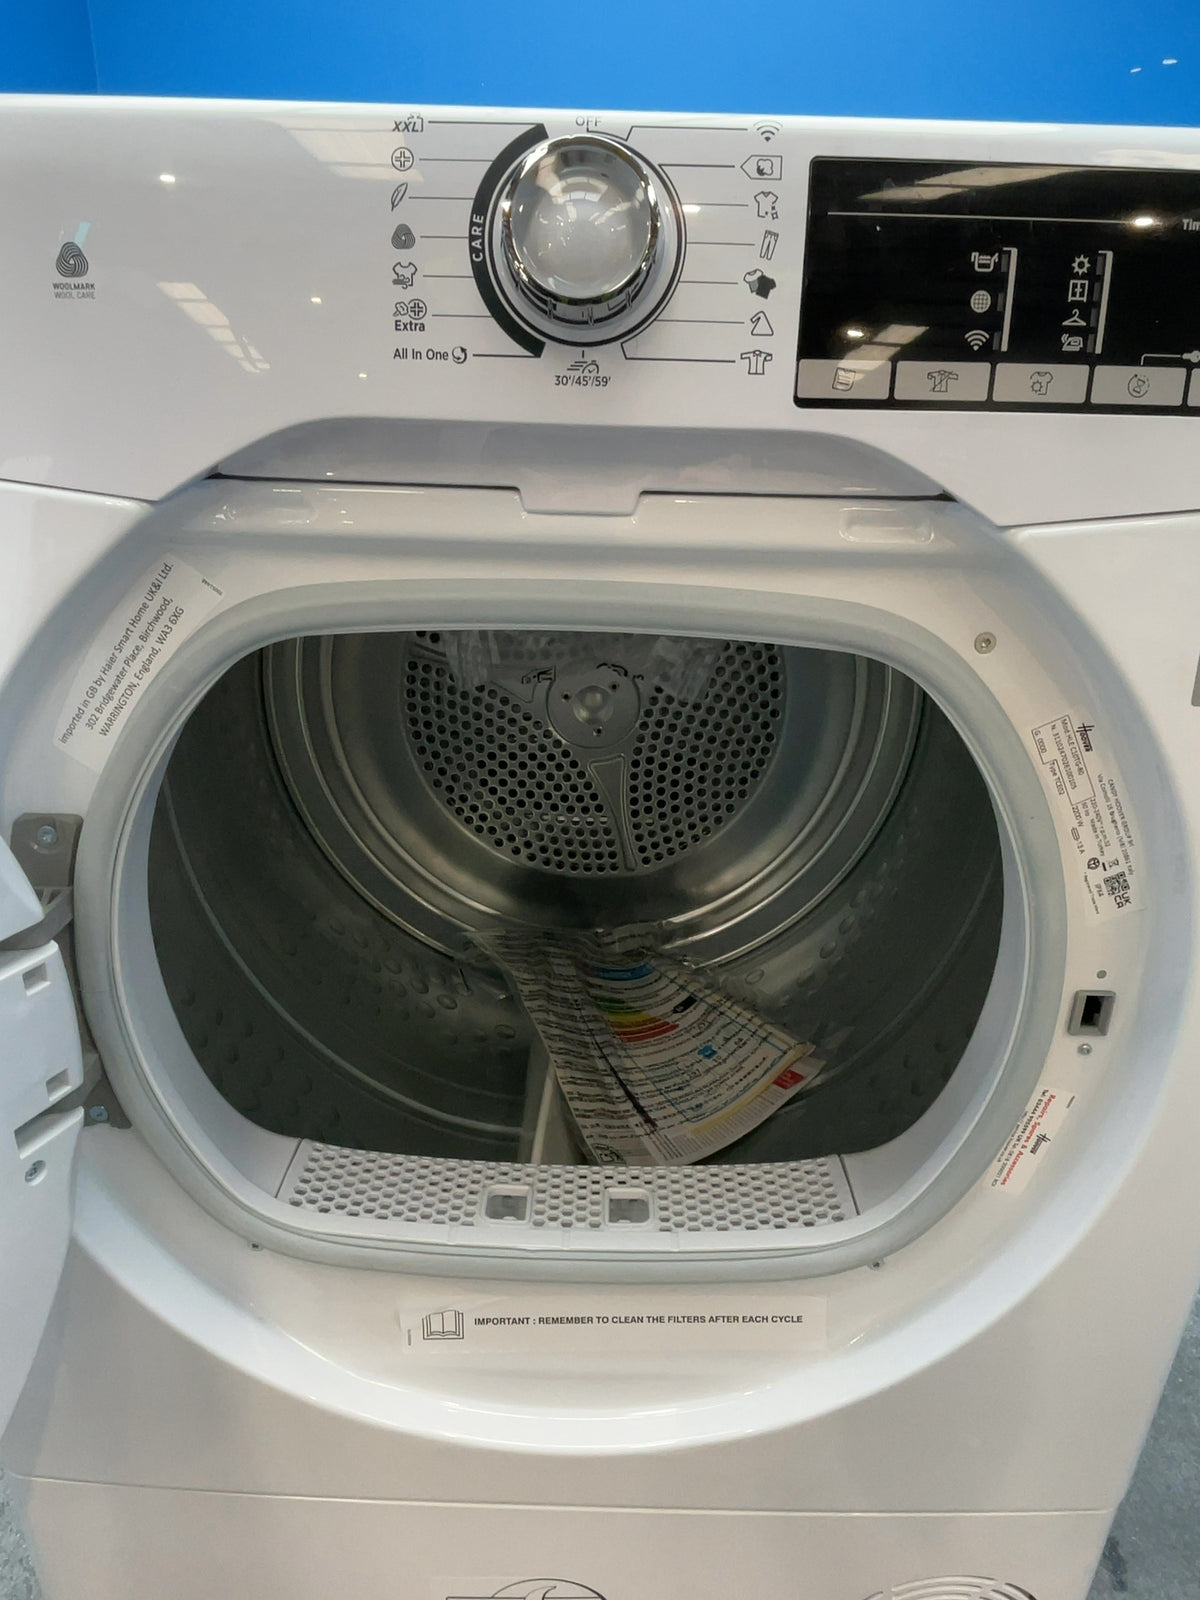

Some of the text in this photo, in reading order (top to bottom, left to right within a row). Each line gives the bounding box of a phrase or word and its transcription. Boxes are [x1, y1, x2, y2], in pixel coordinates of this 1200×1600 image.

[392, 120, 419, 133] XXL
[575, 115, 602, 127] OFF
[471, 213, 485, 262] CARE
[52, 282, 96, 291] WOOLMARK
[54, 291, 97, 300] WOOL CARE
[394, 319, 426, 332] Extra
[393, 347, 449, 361] All In One
[155, 558, 175, 581] Ltd.
[126, 599, 151, 629] Home
[111, 625, 135, 654] Smart
[83, 592, 175, 731] 302 Bridgewater Place, Birchwood,
[97, 650, 120, 677] Haier
[97, 604, 185, 738] WARRINGTON, England, WA3 6XG
[91, 672, 107, 688] by
[83, 683, 99, 700] GB
[78, 696, 91, 709] in
[1046, 761, 1059, 778] Type
[1112, 893, 1124, 909] CA
[1120, 890, 1132, 906] UK
[474, 1317, 531, 1326] IMPORTANT
[538, 1316, 594, 1325] REMEMBER
[596, 1316, 610, 1325] TO
[611, 1316, 644, 1325] CLEAN
[646, 1315, 666, 1324] THE
[667, 1315, 706, 1324] FILTERS
[708, 1315, 739, 1324] AFTER
[741, 1315, 769, 1324] EACH
[771, 1315, 803, 1324] CYCLE
